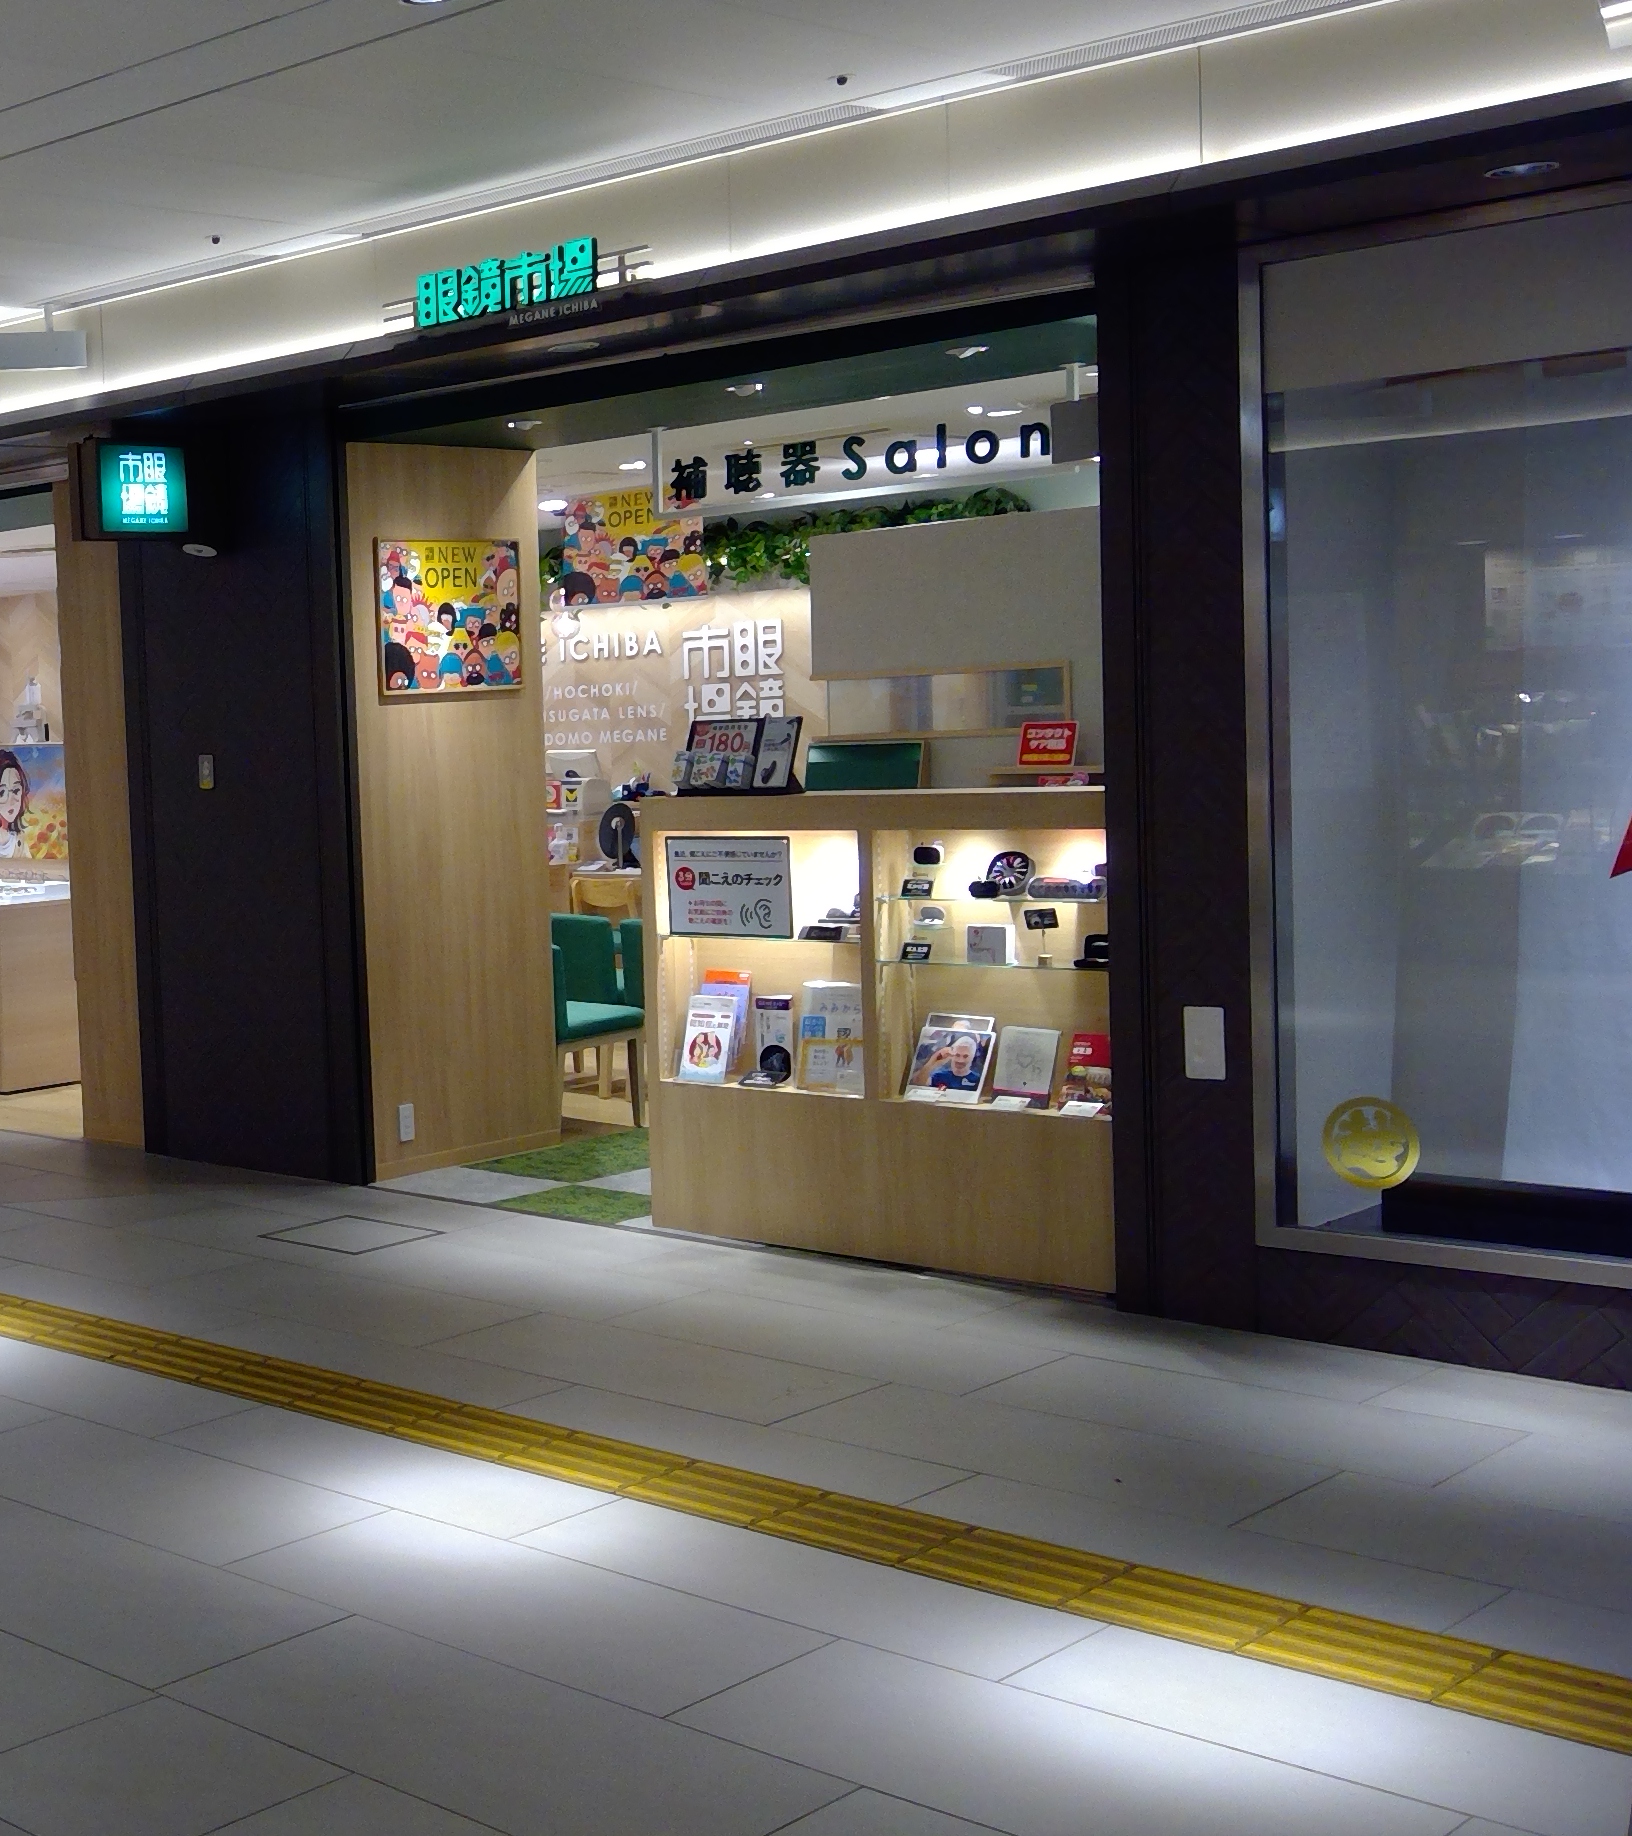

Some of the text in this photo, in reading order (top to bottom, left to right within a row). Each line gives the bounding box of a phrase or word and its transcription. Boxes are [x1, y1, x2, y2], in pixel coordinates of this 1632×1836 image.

[418, 236, 597, 327] 眼鏡市場
[509, 298, 600, 326] MEGANE ICHIBA
[438, 546, 477, 564] NEW
[424, 567, 477, 589] OPEN
[558, 629, 663, 662] ICHIBA
[599, 727, 668, 744] MEGANE
[698, 871, 783, 886] 聞こえのチェック
